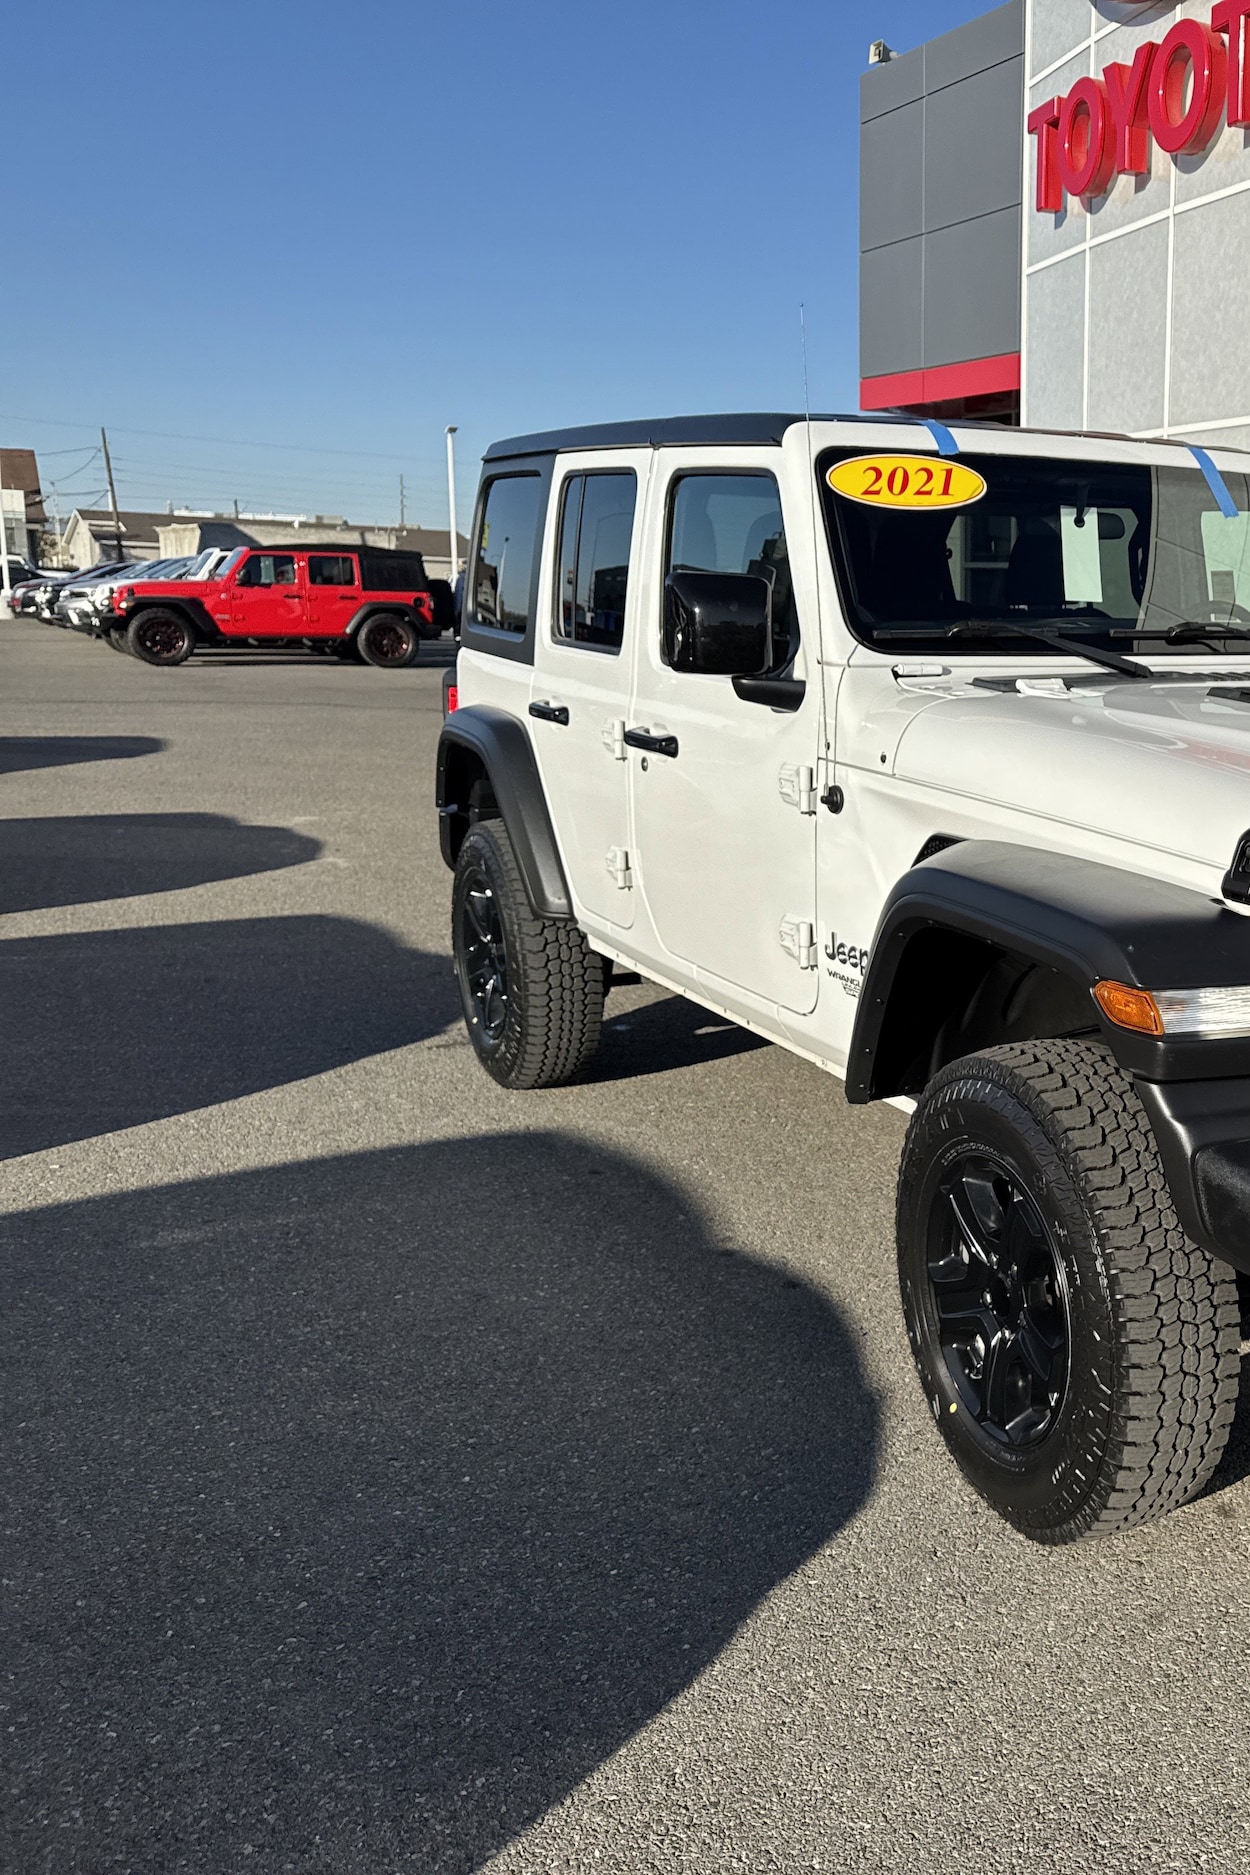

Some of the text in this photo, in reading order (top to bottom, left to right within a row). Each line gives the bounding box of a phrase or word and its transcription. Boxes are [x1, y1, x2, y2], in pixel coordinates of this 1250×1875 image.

[860, 465, 955, 497] 2021
[824, 931, 869, 977] Jeep
[826, 967, 861, 988] WRANGL
